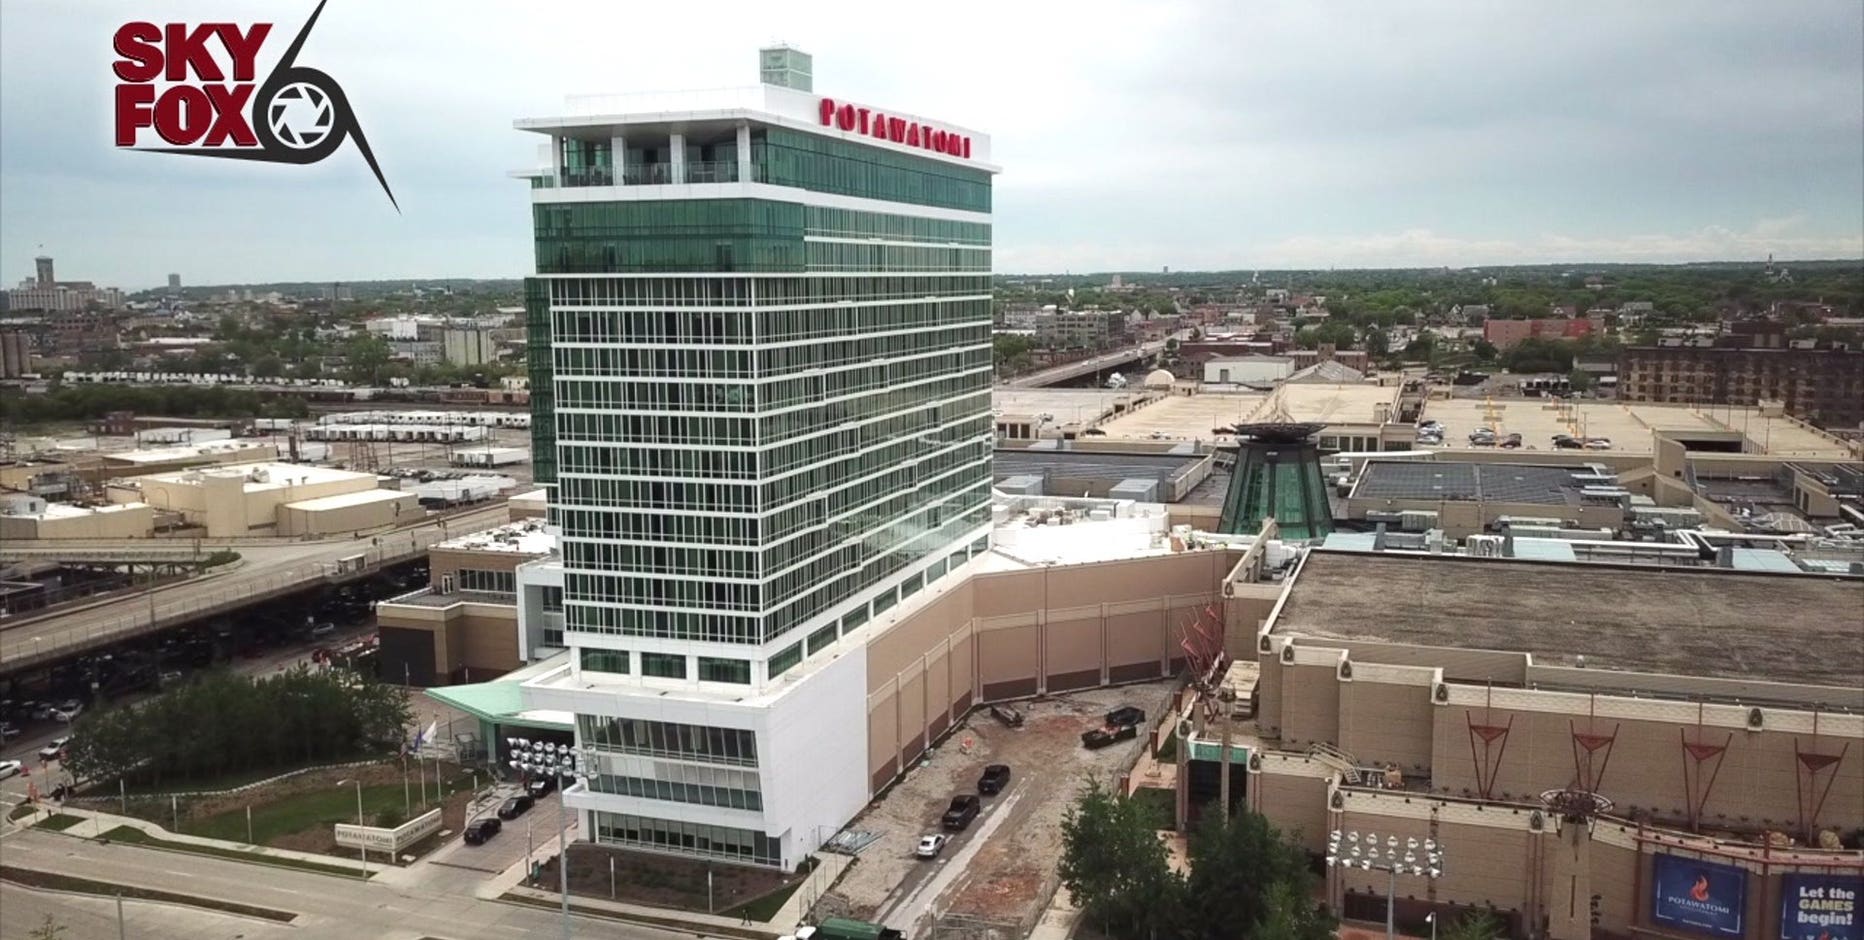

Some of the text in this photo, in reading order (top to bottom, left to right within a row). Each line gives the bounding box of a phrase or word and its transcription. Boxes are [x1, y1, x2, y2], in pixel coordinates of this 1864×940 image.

[819, 98, 971, 159] POTAWATOMI
[1799, 886, 1855, 900] Let the
[1668, 896, 1730, 914] POTAWATOMI
[1799, 898, 1854, 911] GAMES
[1797, 911, 1853, 927] begin!
